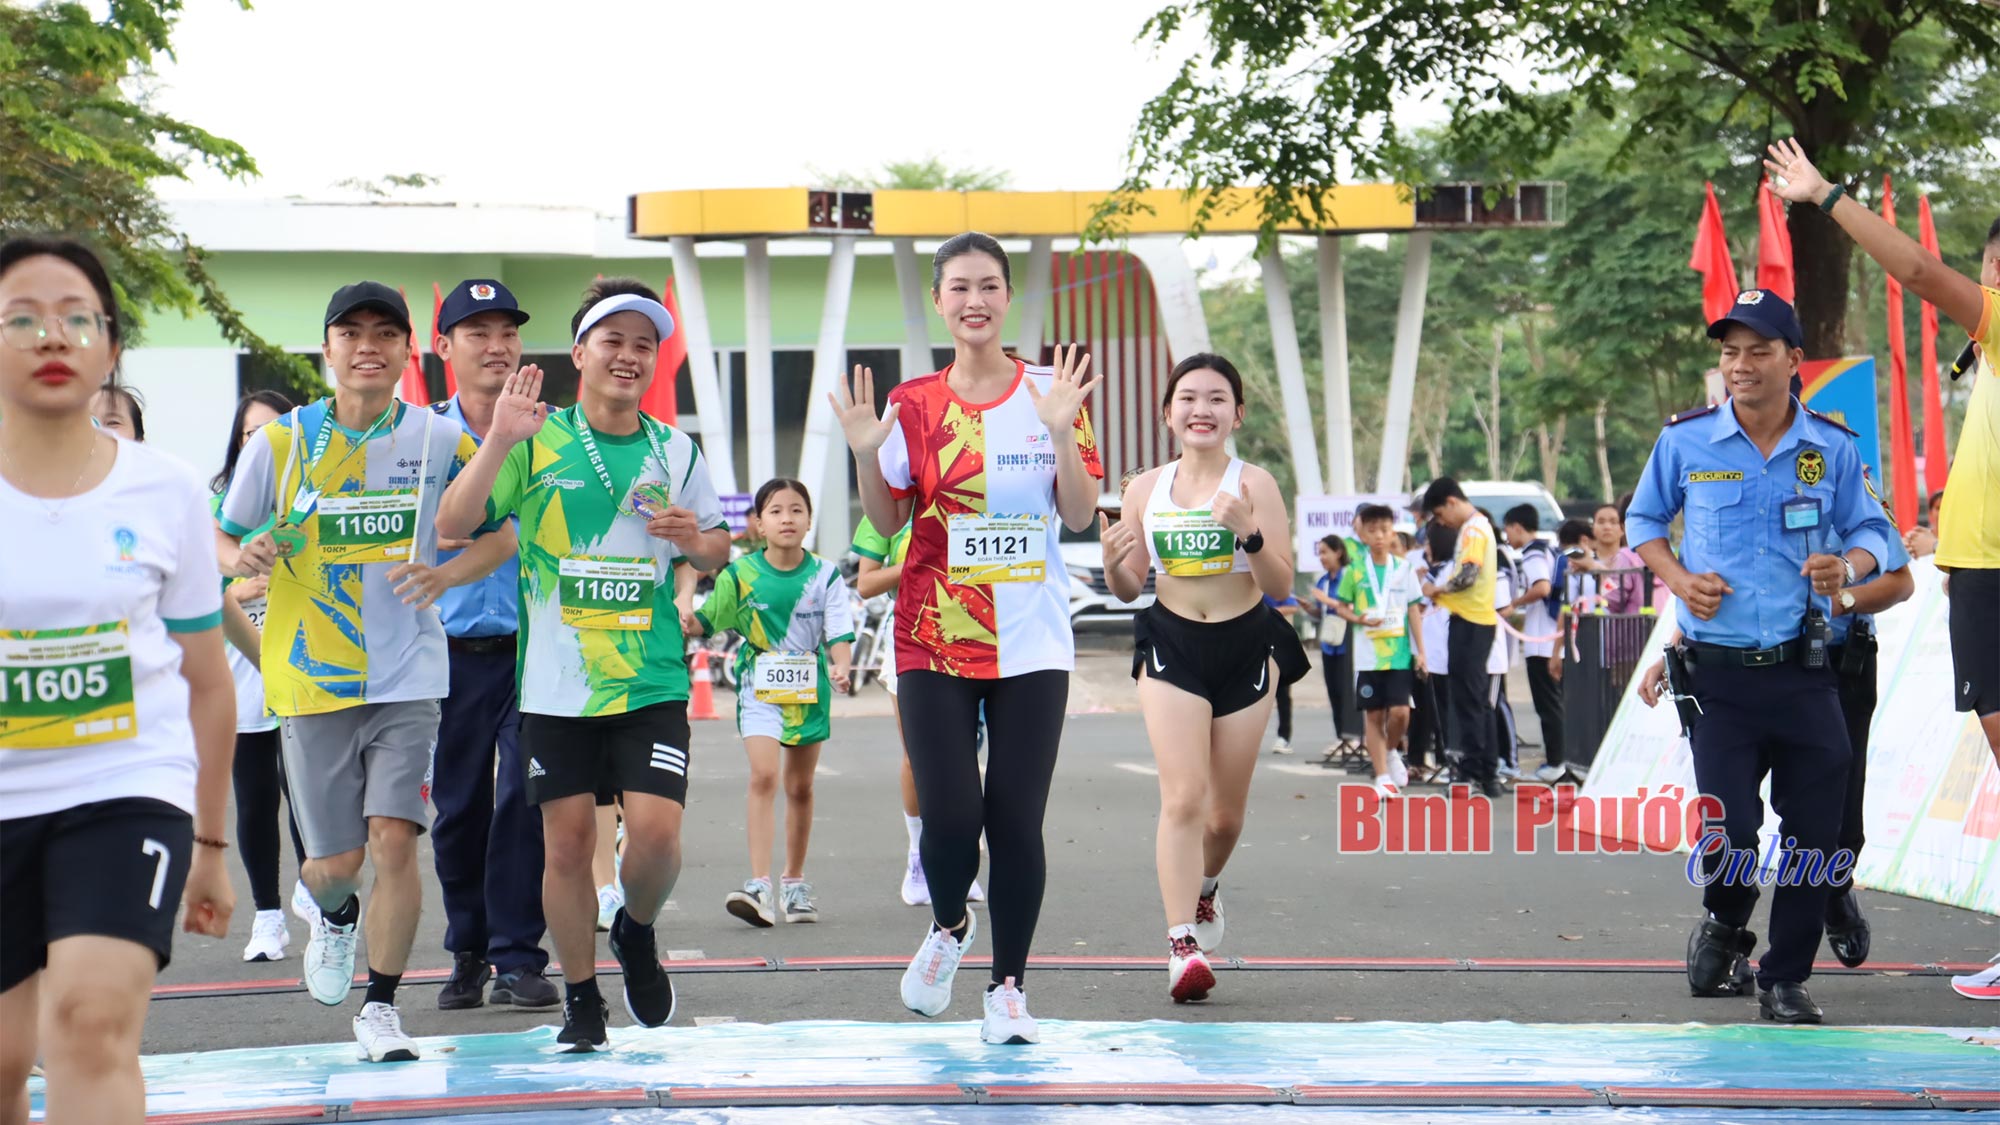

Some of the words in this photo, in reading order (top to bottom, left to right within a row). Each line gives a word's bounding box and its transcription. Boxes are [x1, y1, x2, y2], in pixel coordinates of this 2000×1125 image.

[579, 429, 613, 489] FINISHER
[1697, 471, 1737, 480] SECURITY
[336, 514, 404, 536] 11600
[1307, 511, 1329, 528] KHU
[965, 536, 1028, 556] 51121
[1164, 532, 1221, 551] 11302
[951, 566, 970, 574] 5KM
[574, 579, 641, 602] 11602
[562, 607, 583, 616] 10KM
[0, 664, 109, 702] 11605
[766, 669, 810, 683] 50314
[142, 838, 170, 910] 7
